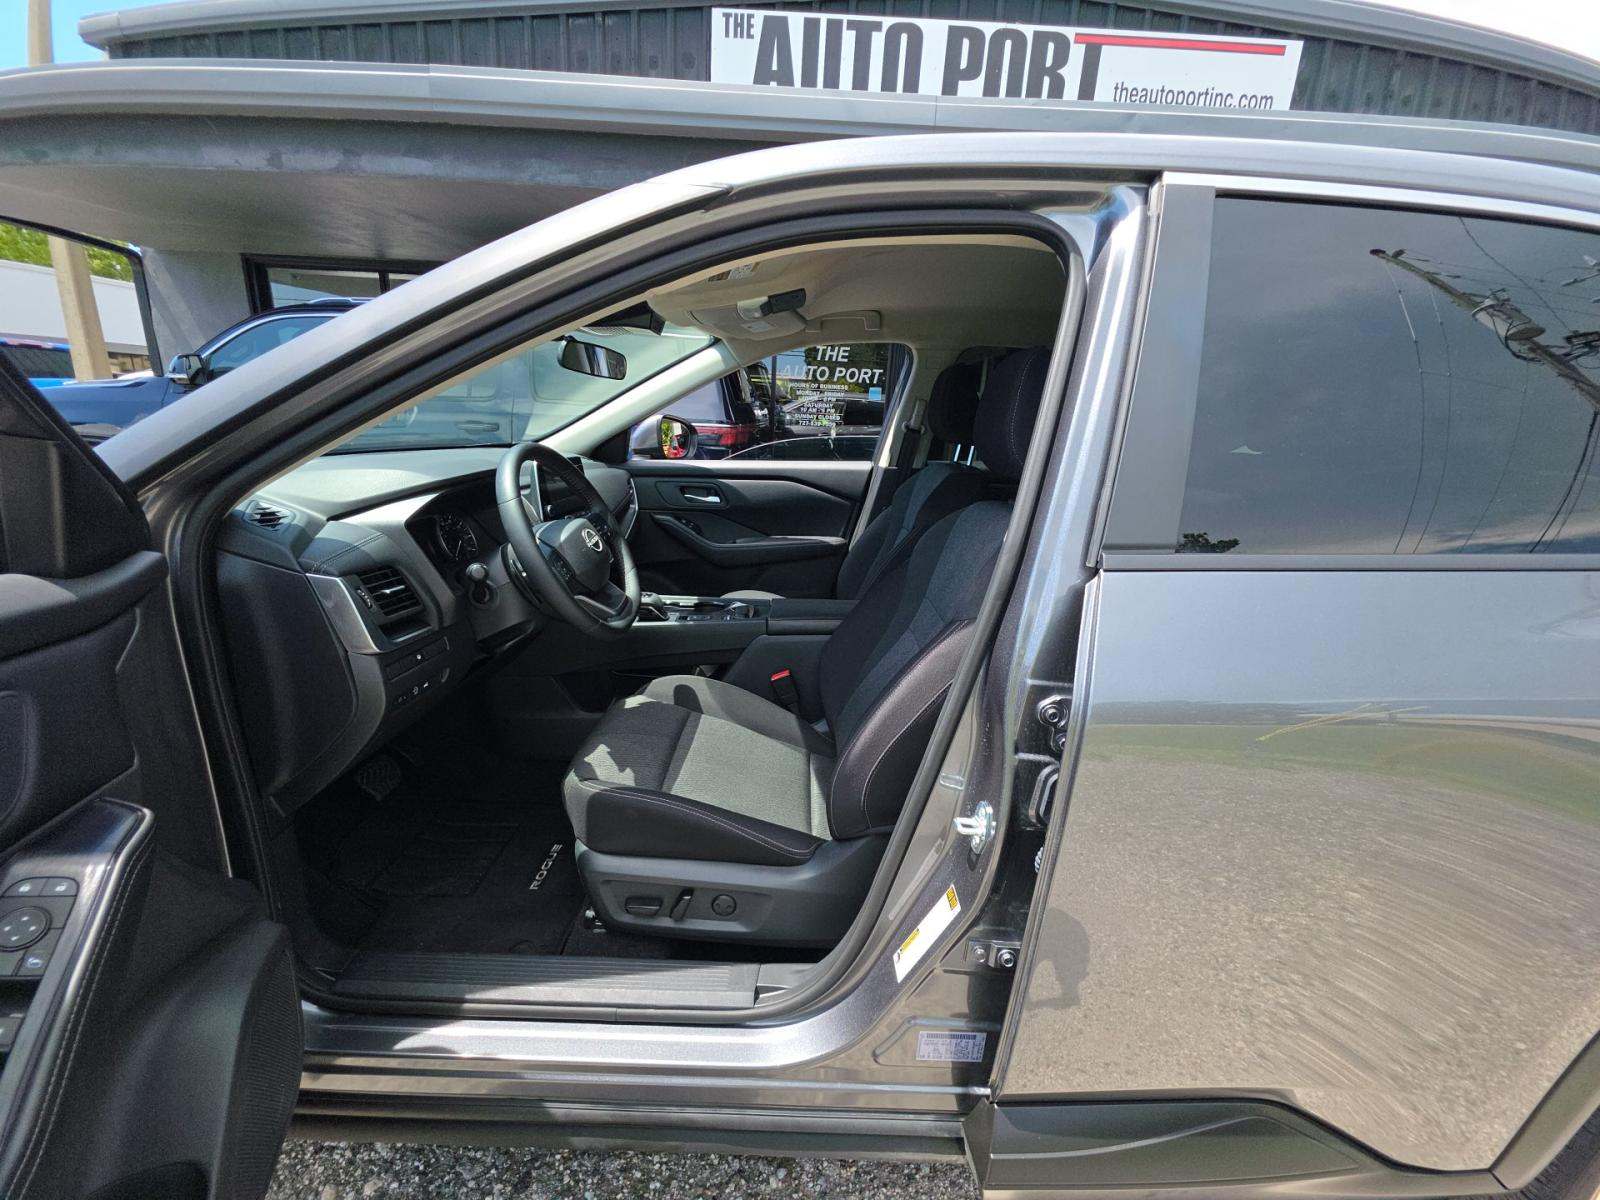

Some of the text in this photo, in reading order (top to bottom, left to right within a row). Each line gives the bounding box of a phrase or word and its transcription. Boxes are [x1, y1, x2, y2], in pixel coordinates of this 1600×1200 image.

[722, 12, 1104, 101] THE AUTO PORT
[1113, 81, 1274, 110] theautoportinc.com
[816, 346, 850, 362] THE
[783, 365, 884, 384] AUTO PORT
[529, 844, 563, 890] ROGUE
